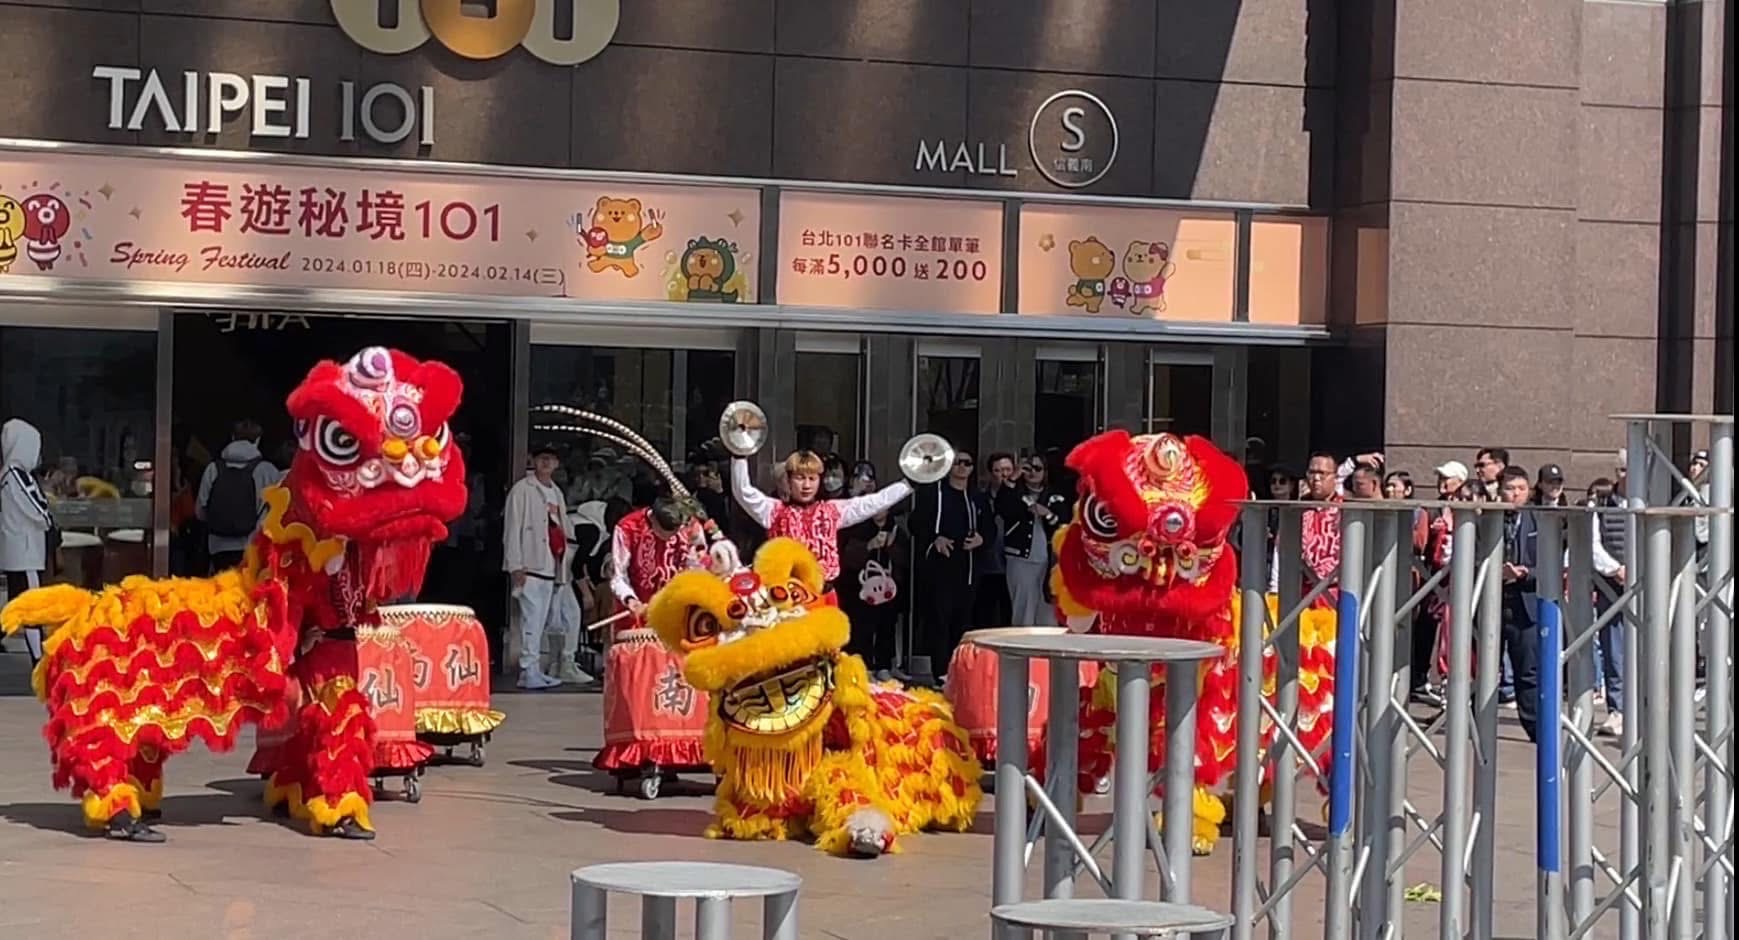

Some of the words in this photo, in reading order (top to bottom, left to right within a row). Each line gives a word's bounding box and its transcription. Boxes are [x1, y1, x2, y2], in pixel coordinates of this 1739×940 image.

[93, 65, 310, 139] TAIPEI
[340, 81, 435, 146] 101
[1061, 107, 1085, 150] S
[915, 139, 1017, 177] MALL
[181, 180, 501, 243] 春遊秘境101
[109, 242, 192, 274] Spring
[199, 246, 291, 271] Festival
[801, 229, 981, 254] 台北101聯名卡全館單筆
[653, 667, 693, 716] 南
